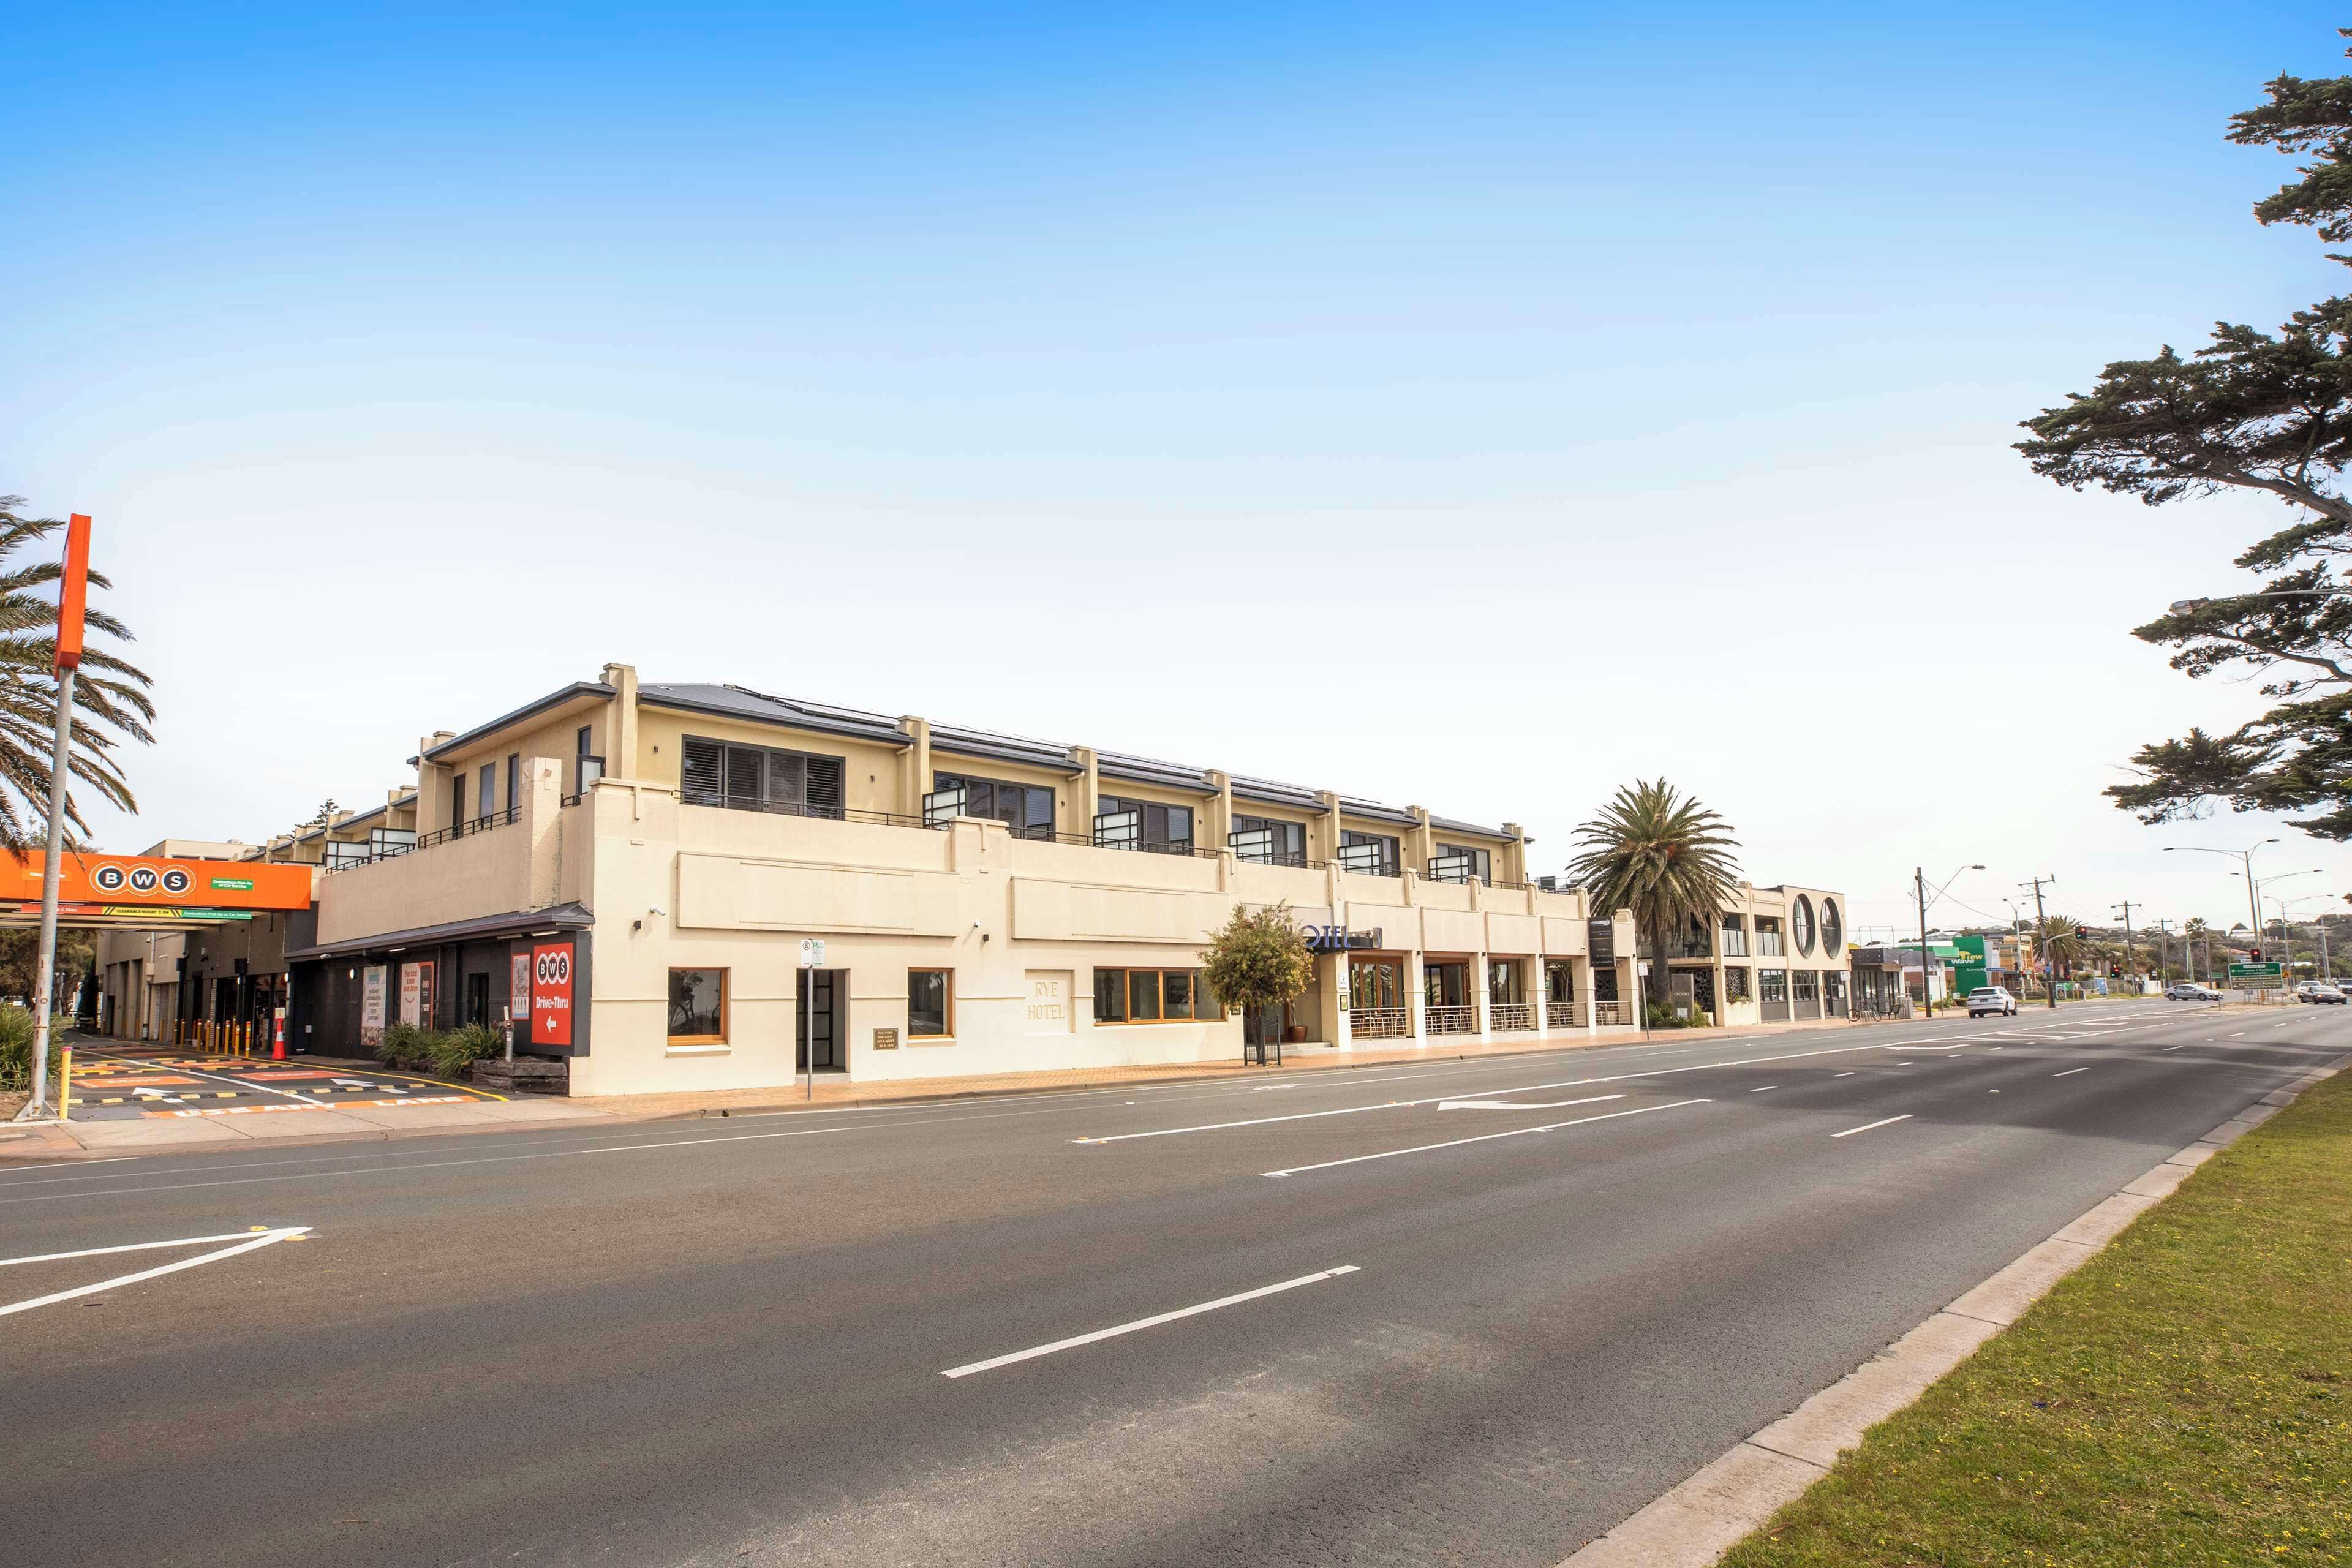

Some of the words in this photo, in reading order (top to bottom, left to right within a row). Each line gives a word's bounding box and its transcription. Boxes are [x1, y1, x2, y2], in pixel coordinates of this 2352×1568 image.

[105, 872, 181, 887] BWS
[541, 962, 565, 975] BWS
[1035, 981, 1058, 997] RYE
[536, 996, 568, 1009] Drive-Thru
[1028, 1004, 1066, 1020] HOTEL
[175, 1106, 252, 1117] USE
[263, 1102, 336, 1112] ANY
[372, 1096, 461, 1106] LANE
